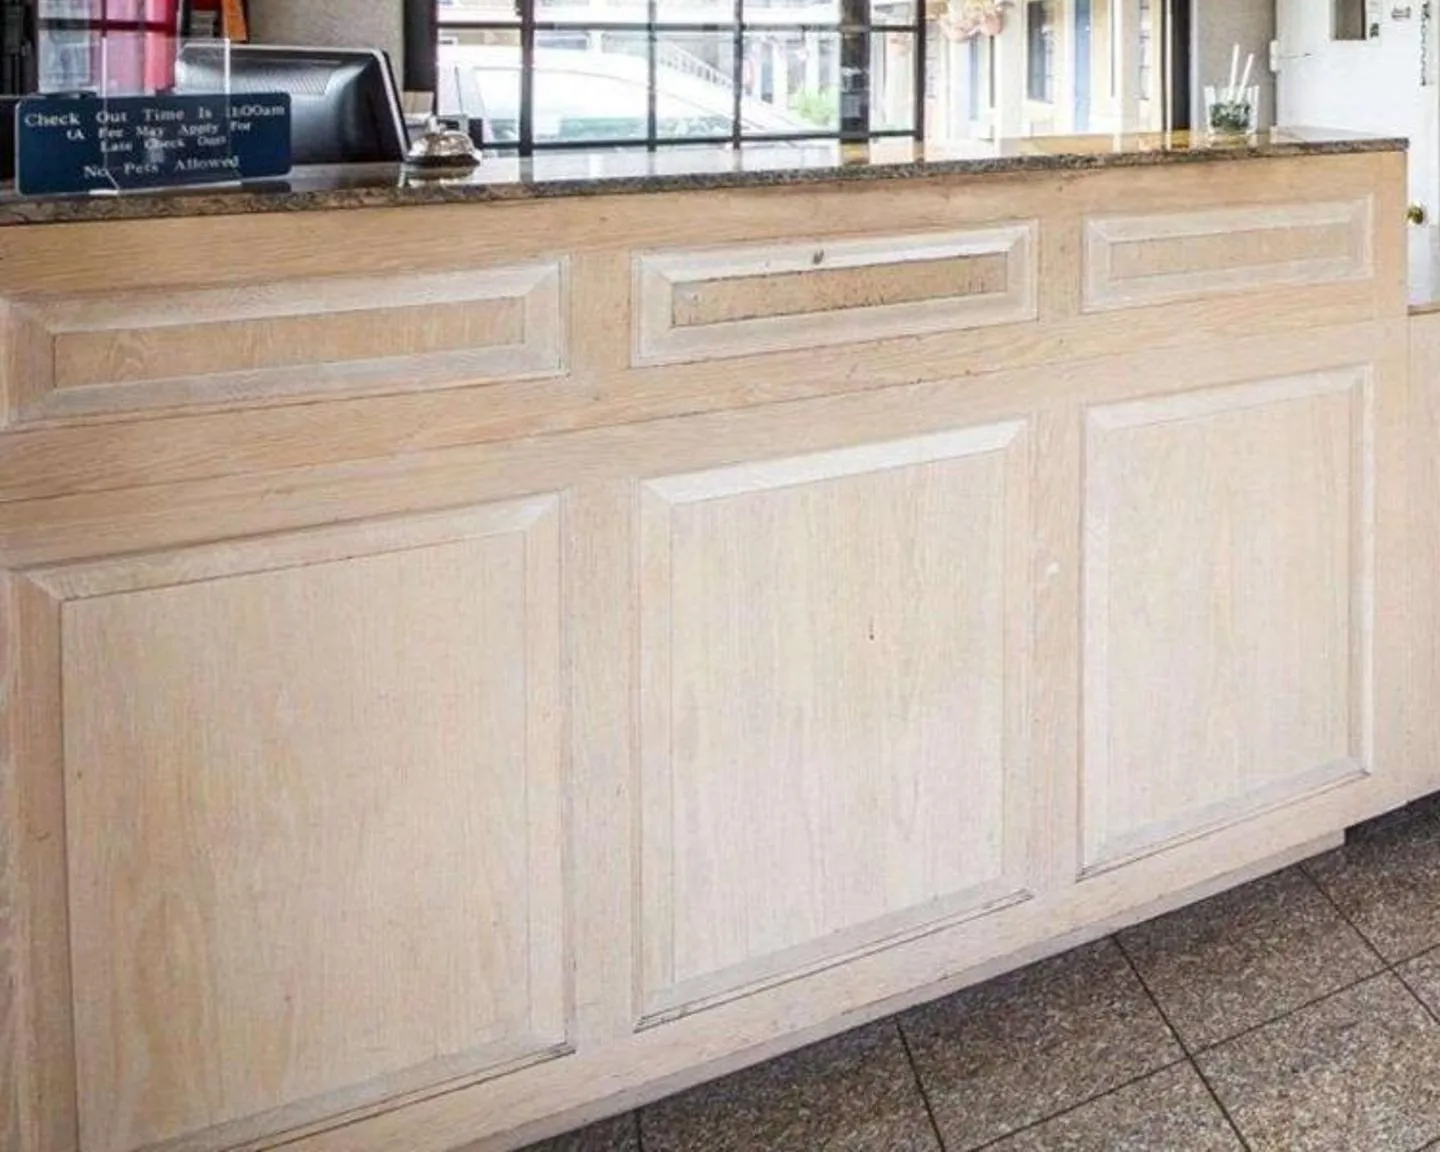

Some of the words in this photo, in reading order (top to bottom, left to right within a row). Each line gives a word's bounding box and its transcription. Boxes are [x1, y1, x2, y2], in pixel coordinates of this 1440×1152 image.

[24, 111, 81, 127] Check
[96, 109, 127, 124] Out
[144, 107, 185, 123] Time
